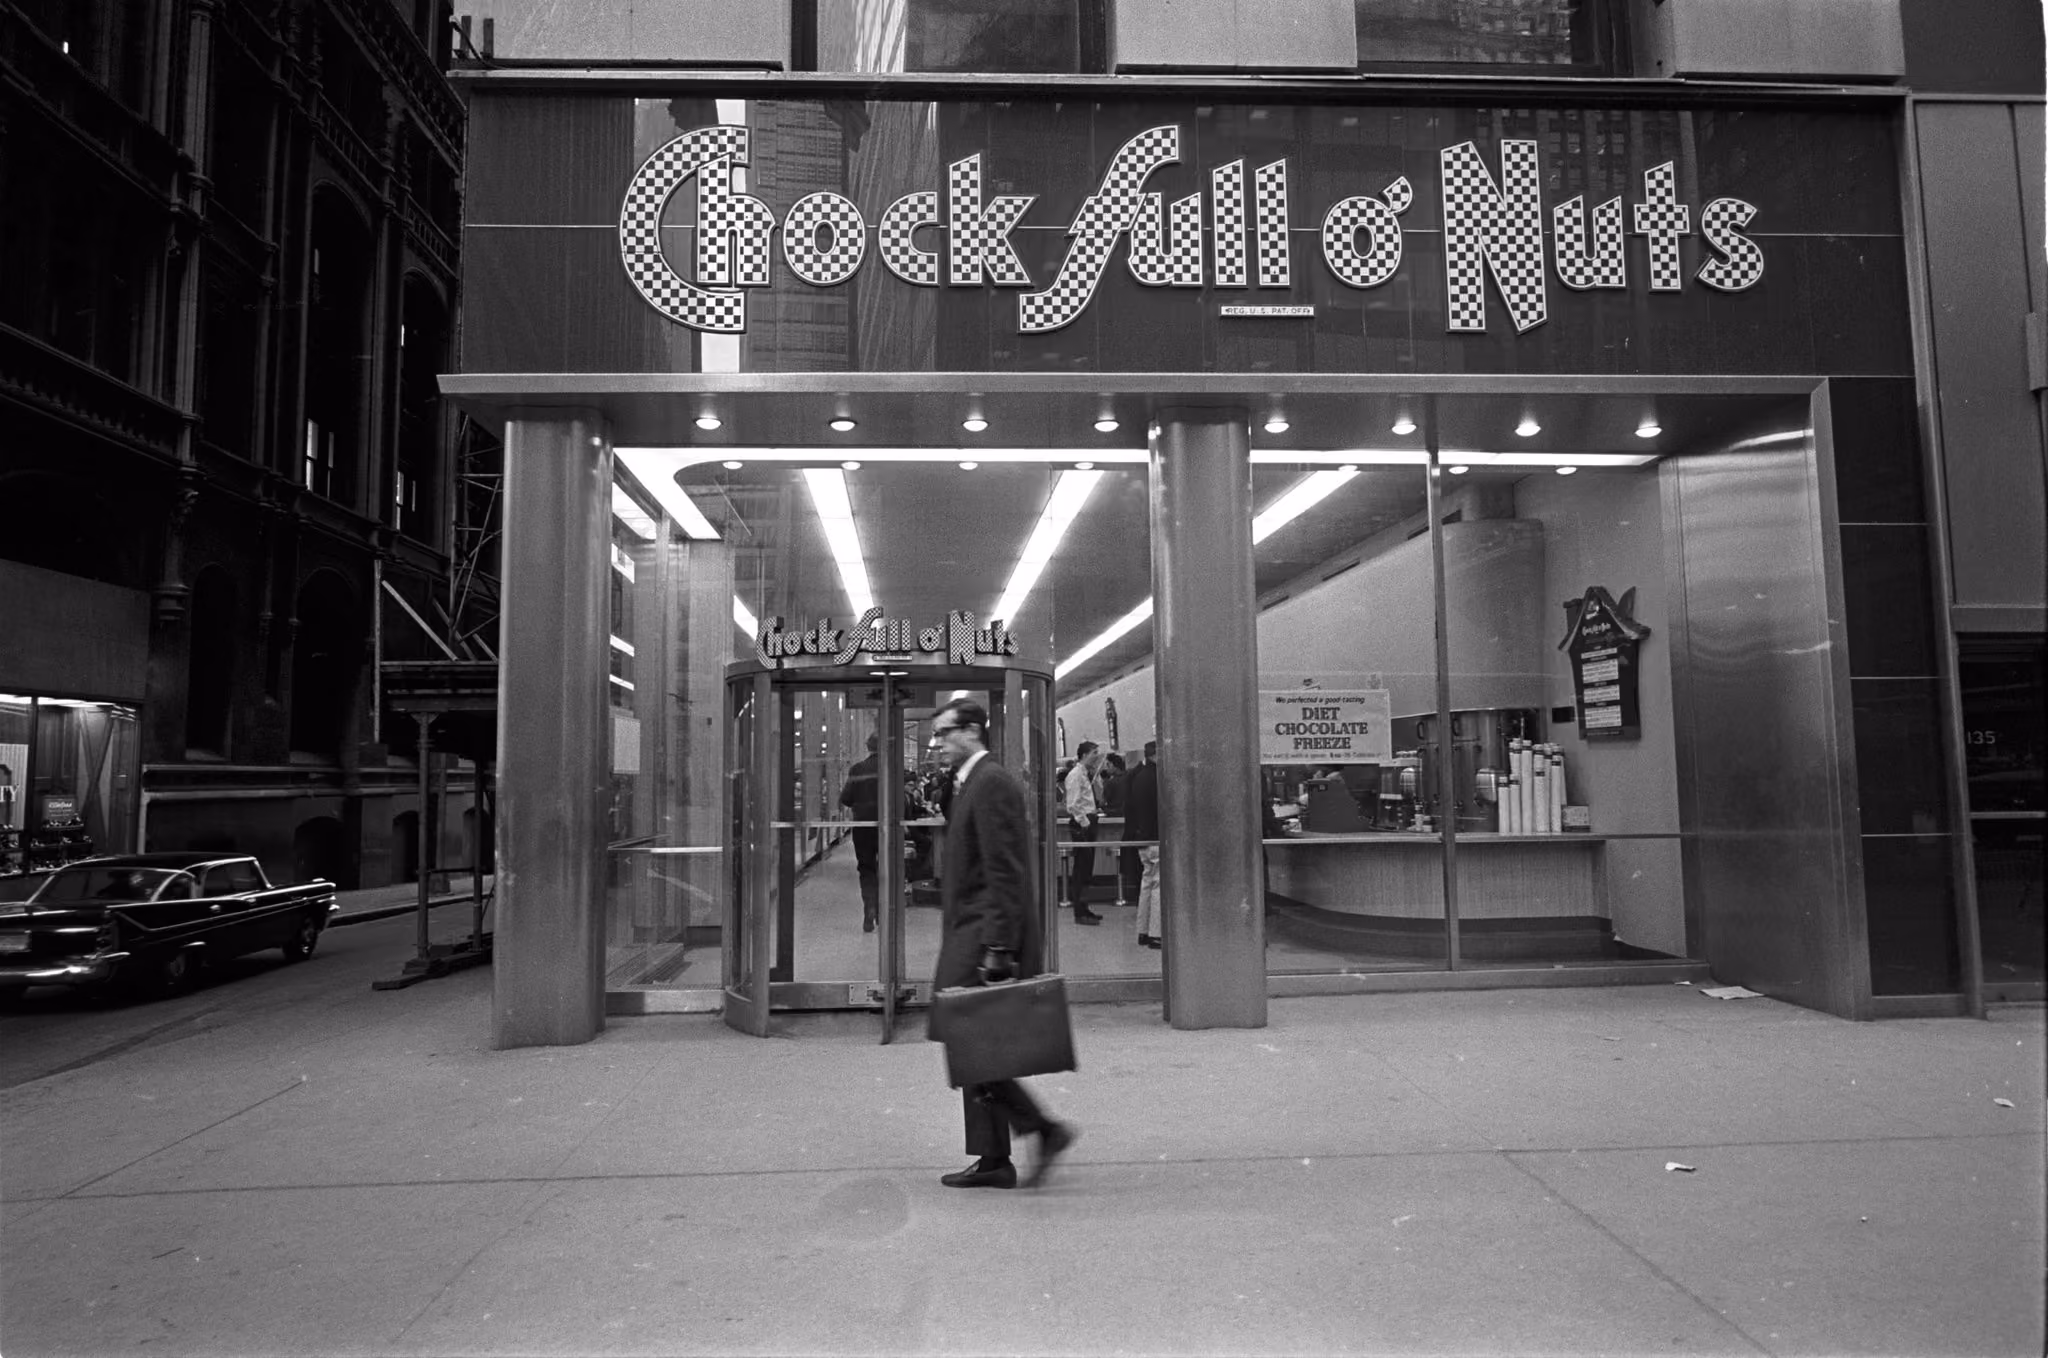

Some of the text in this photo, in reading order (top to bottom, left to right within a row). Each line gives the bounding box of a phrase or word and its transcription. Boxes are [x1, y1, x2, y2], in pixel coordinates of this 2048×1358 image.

[620, 125, 1765, 334] Chock full o' Nuts
[756, 616, 844, 669] Chock
[833, 607, 911, 665] full
[948, 609, 1020, 666] Nuts
[1302, 706, 1341, 720] DIET
[1274, 722, 1369, 735] CHOCOLATE
[1293, 737, 1352, 750] FREEZE
[1967, 730, 1996, 744] 135
